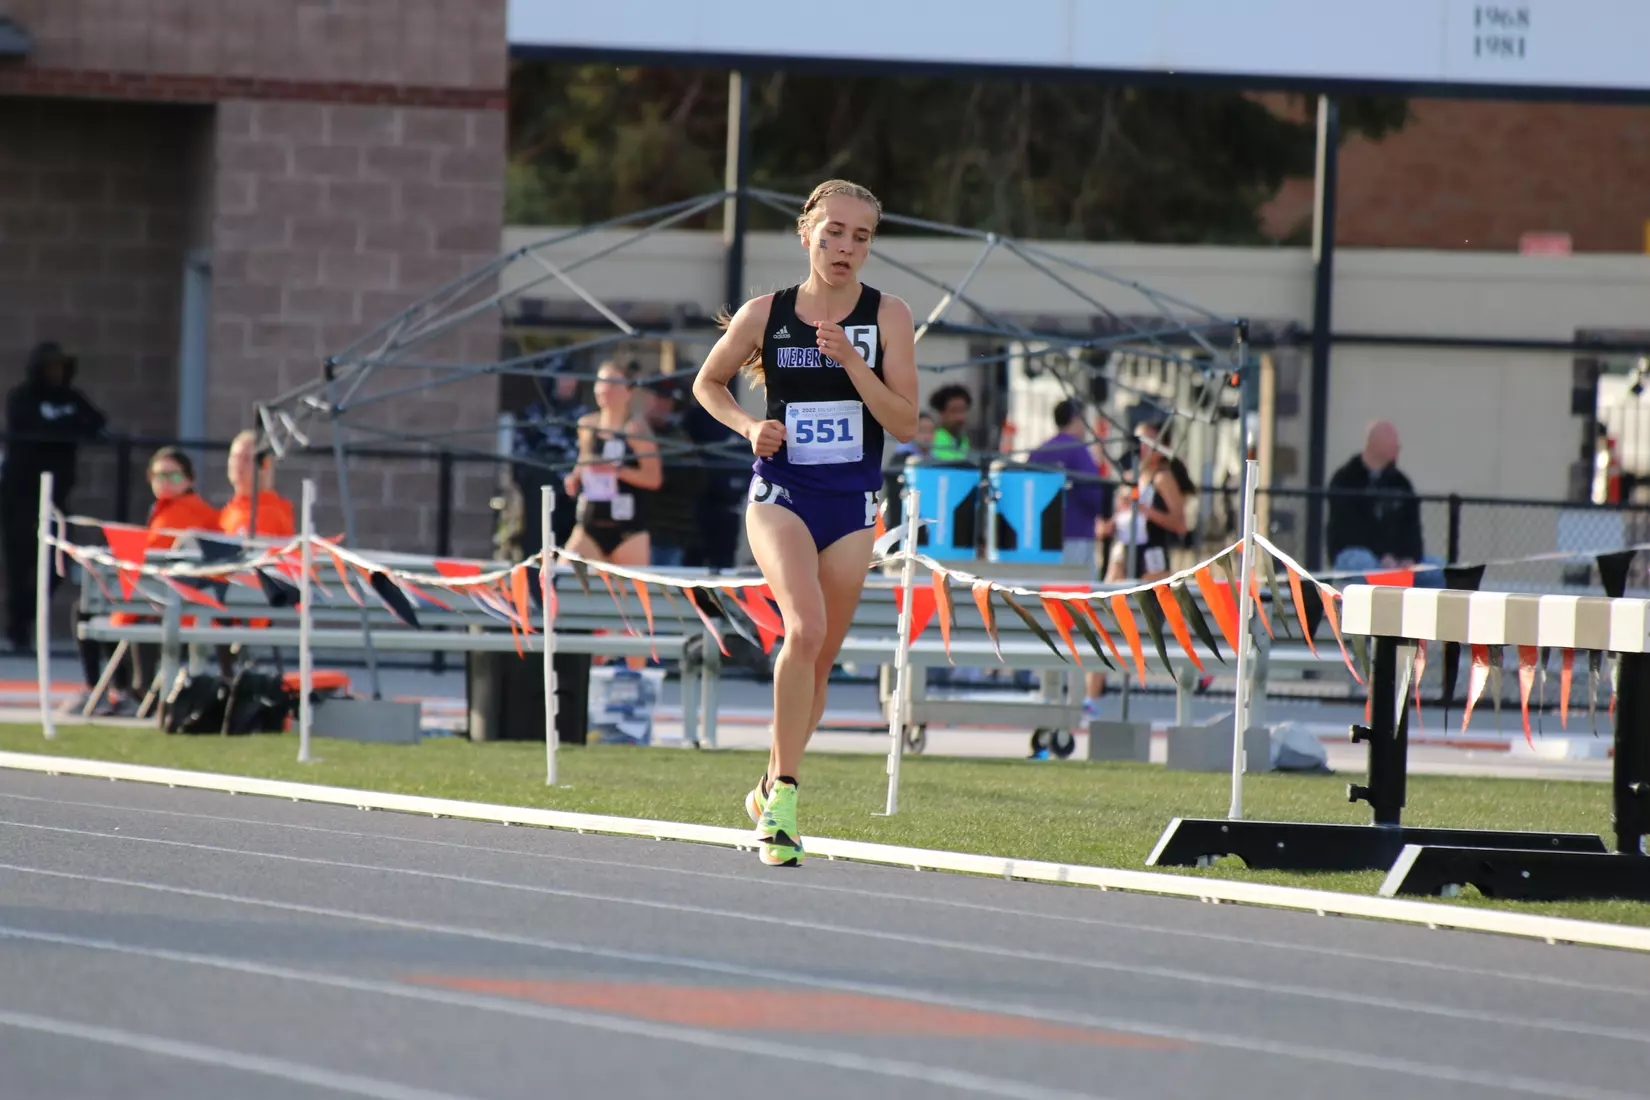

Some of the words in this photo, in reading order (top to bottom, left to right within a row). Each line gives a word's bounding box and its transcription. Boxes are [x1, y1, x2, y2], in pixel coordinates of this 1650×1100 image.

[1474, 35, 1526, 58] 1981
[853, 328, 870, 362] 5
[777, 347, 822, 368] WEBER
[796, 418, 854, 444] 551
